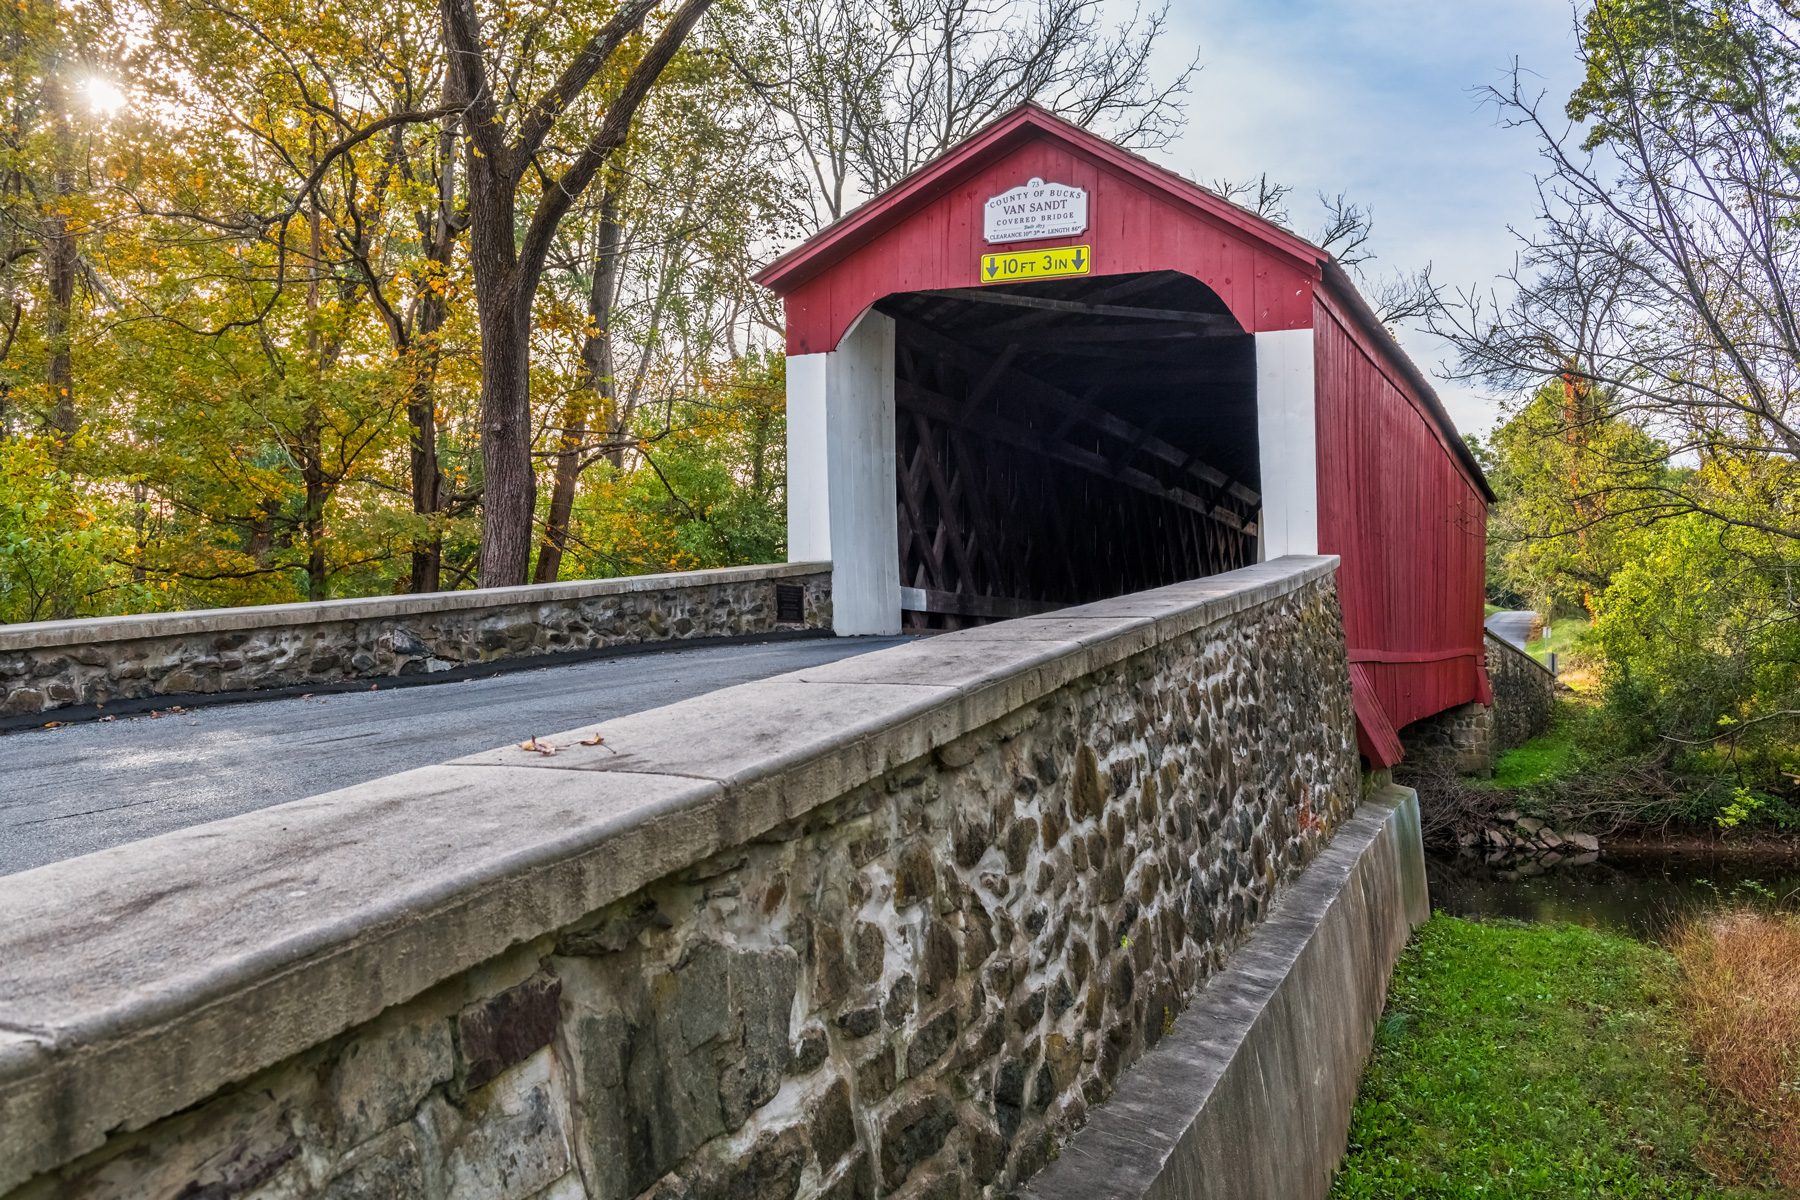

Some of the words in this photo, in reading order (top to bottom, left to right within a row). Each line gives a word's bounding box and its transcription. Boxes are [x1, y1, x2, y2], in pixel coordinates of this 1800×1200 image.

[989, 192, 1029, 209] COUNTY
[1033, 190, 1045, 198] OF
[1049, 189, 1082, 199] BUCKS
[1003, 204, 1026, 215] VAN
[1029, 199, 1068, 213] SANDT
[996, 216, 1037, 226] COVERED
[1041, 212, 1074, 221] BRIDGE
[989, 231, 1022, 240] CLEARANCE
